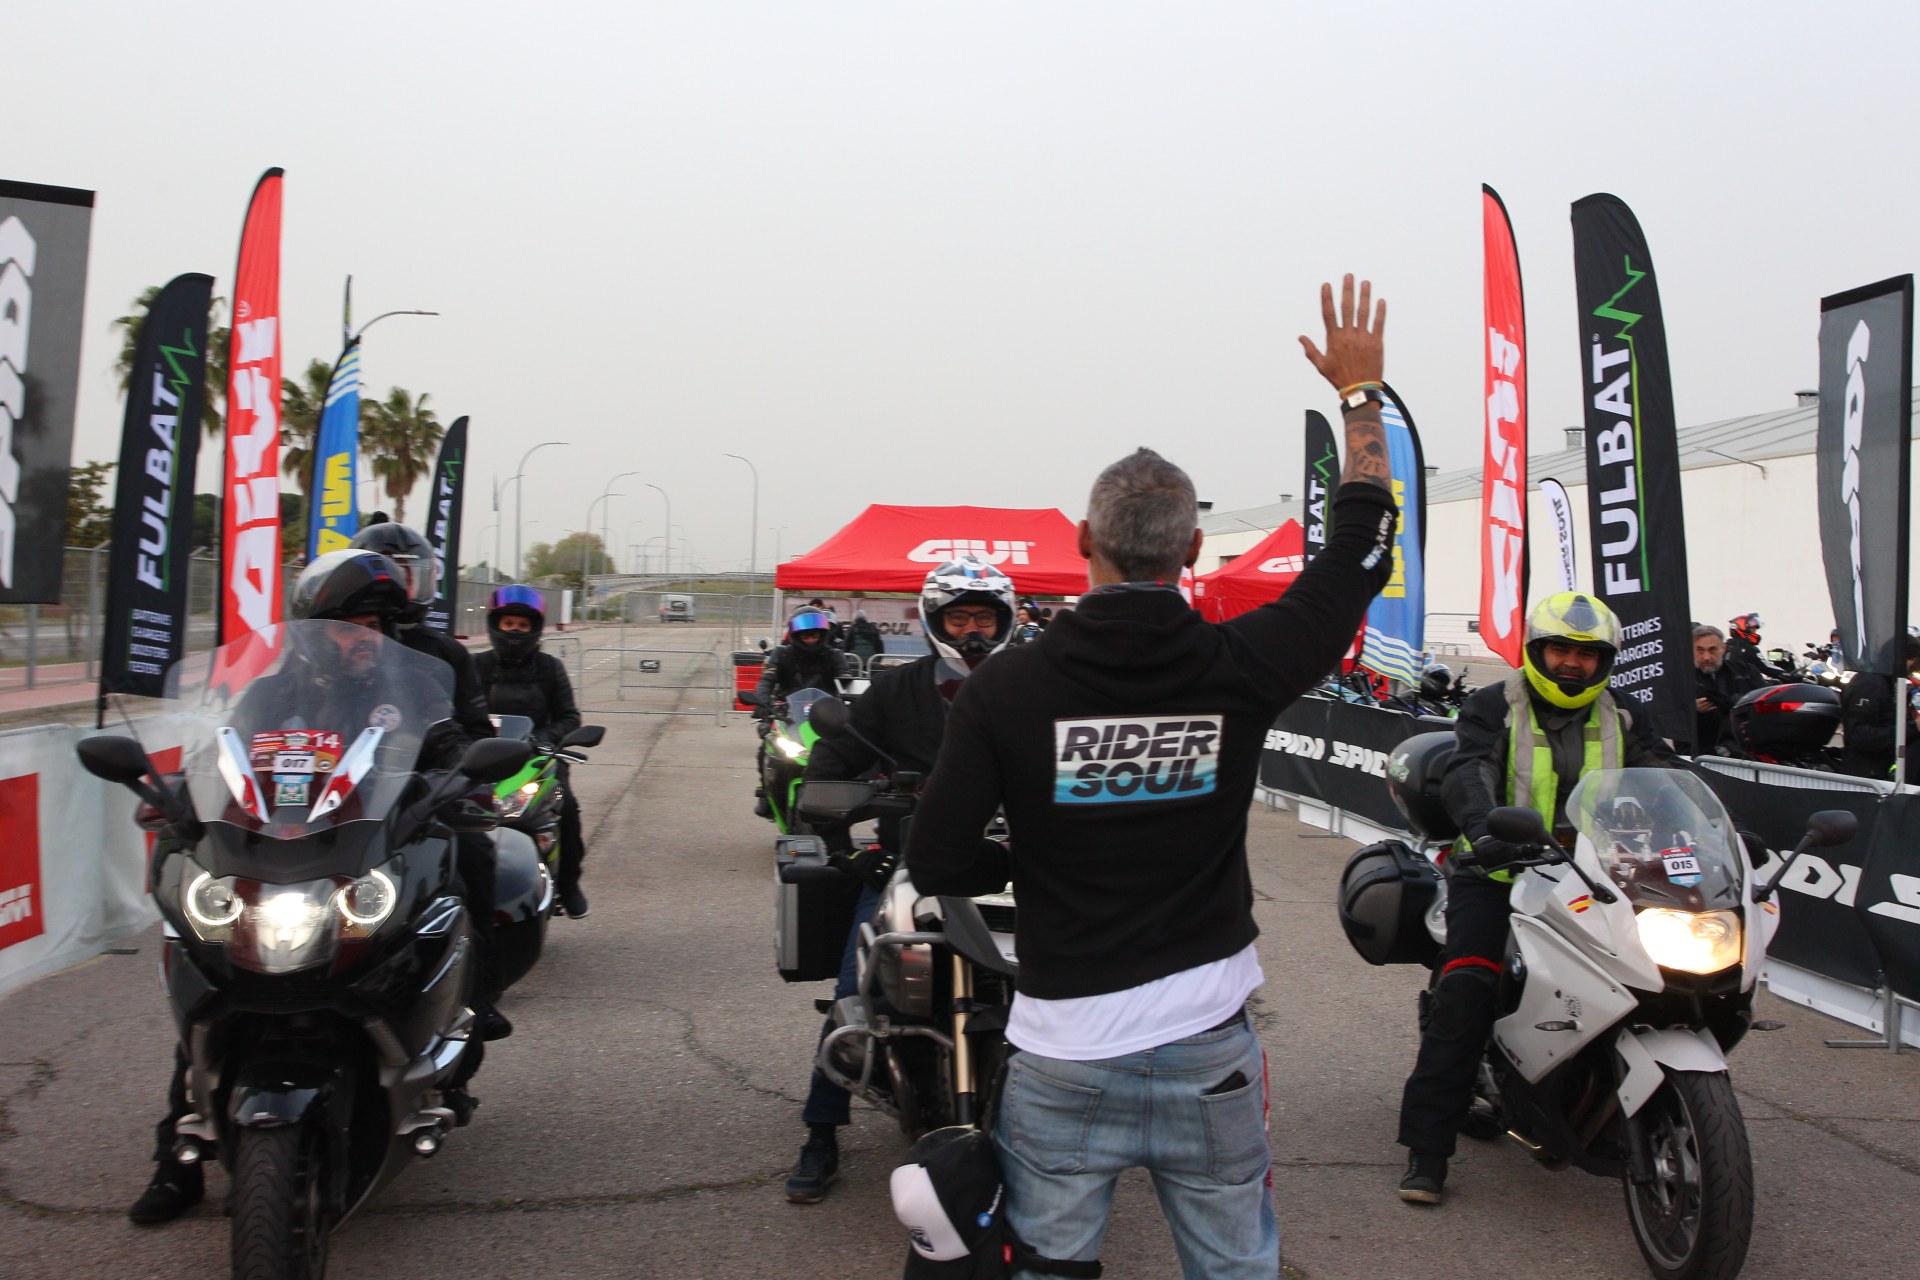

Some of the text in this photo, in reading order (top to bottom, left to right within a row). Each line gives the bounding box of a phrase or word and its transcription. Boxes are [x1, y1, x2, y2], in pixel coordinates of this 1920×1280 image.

[136, 371, 179, 589] FULBAT
[1592, 343, 1641, 595] FULBAT
[1308, 480, 1326, 561] BAT
[907, 539, 1030, 565] GIVI
[1257, 554, 1304, 573] GI
[1620, 616, 1662, 641] TTERIES
[1614, 639, 1664, 666] HARGERS
[1609, 662, 1664, 688] BOOSTERS
[313, 733, 340, 748] 14
[1060, 720, 1218, 762] RIDER
[1263, 728, 1389, 779] SPIDI SPID
[1069, 758, 1206, 798] SOUL
[1671, 860, 1693, 870] 015
